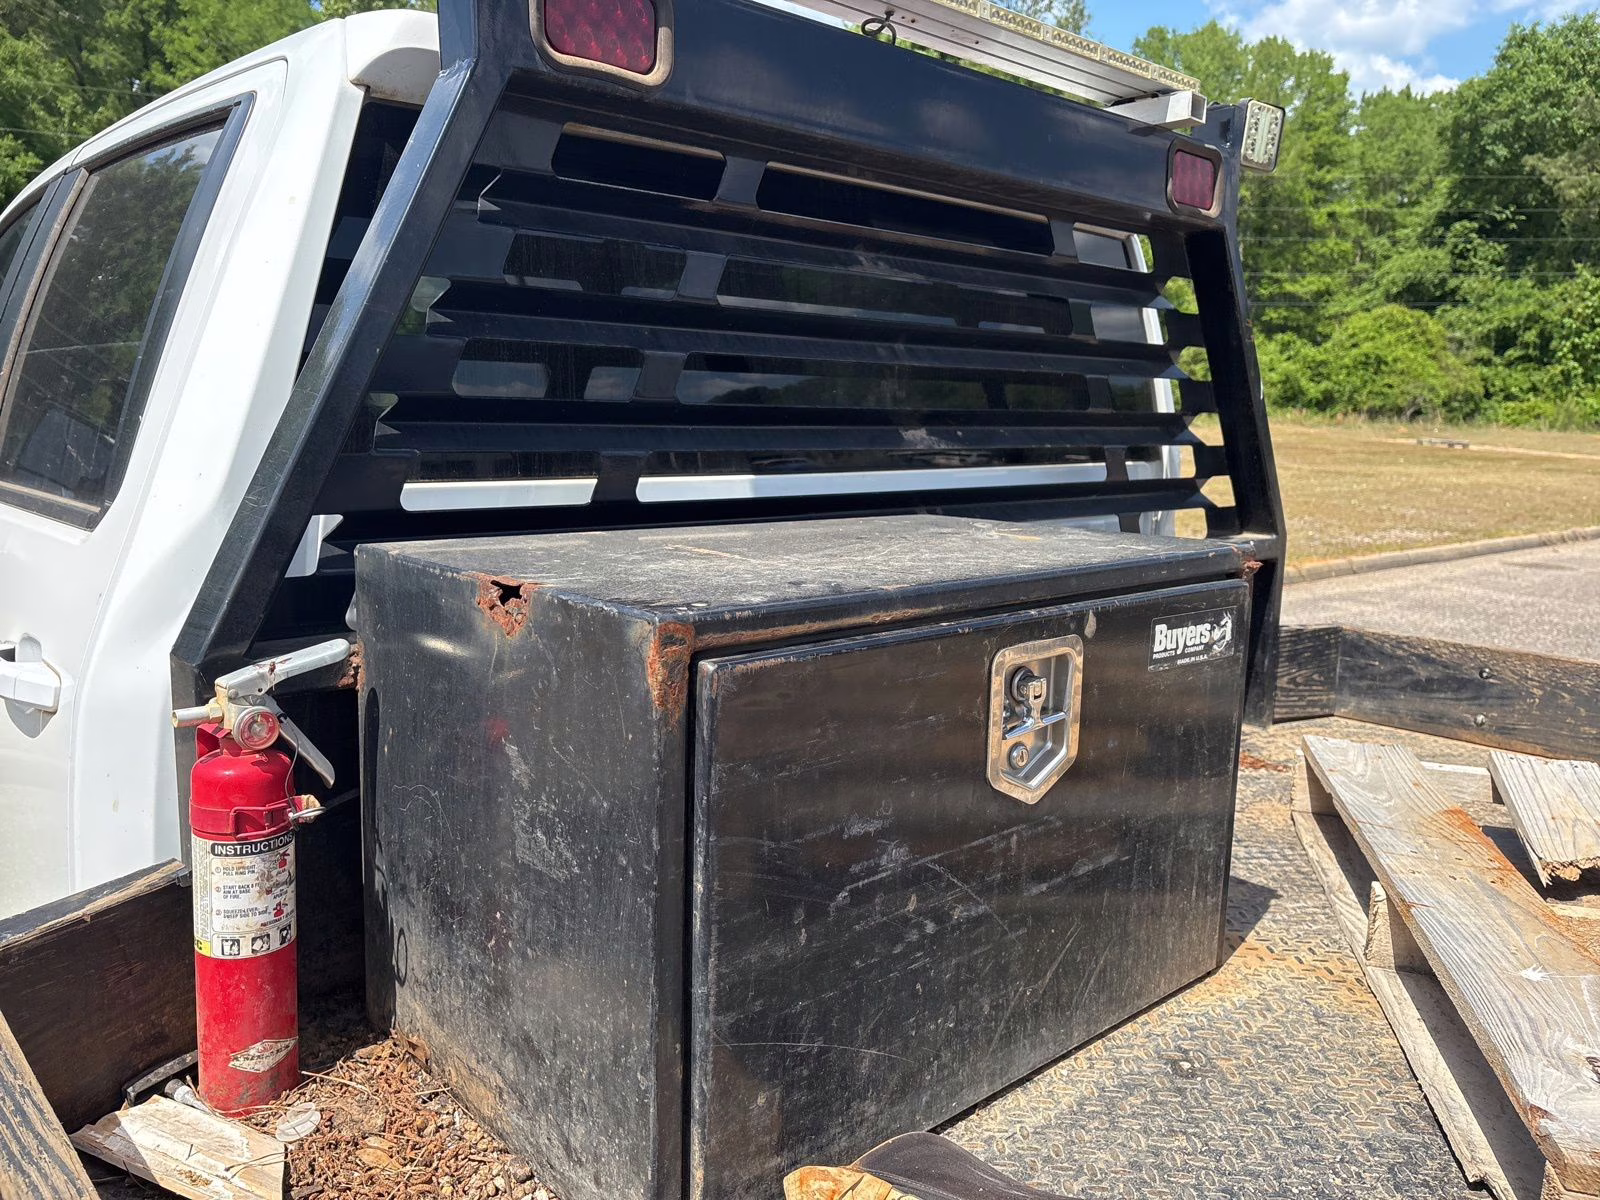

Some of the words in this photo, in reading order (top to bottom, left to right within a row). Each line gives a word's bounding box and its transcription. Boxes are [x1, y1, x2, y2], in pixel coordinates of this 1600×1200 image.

[1154, 623, 1212, 654] Buyers
[1152, 650, 1176, 660] PRODUCTS
[1184, 644, 1205, 653] COMPANY
[214, 834, 294, 855] INSTRUCTIONS
